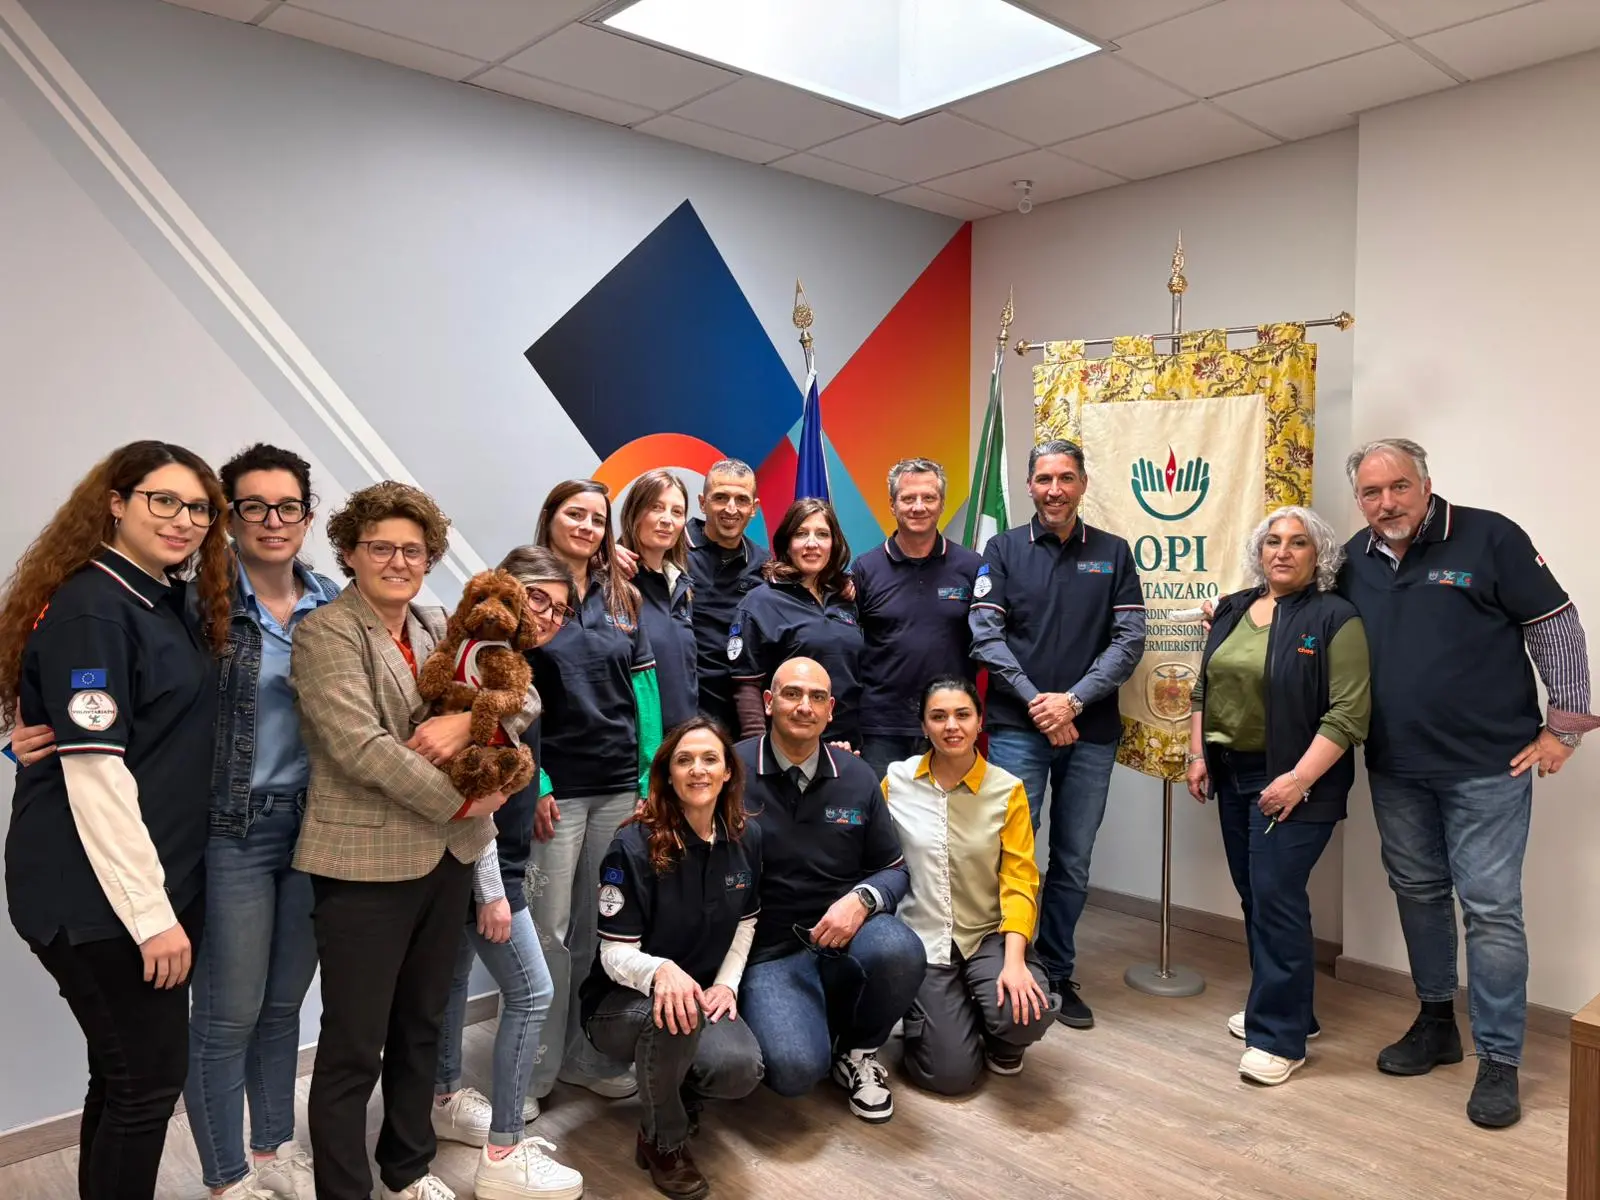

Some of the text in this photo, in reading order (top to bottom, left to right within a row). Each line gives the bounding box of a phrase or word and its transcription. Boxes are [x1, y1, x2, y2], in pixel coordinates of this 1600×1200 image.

[1134, 535, 1208, 572] OPI
[1142, 582, 1218, 600] TANZARO
[1144, 608, 1173, 620] RDIN
[1146, 624, 1204, 636] ROFESSIONI
[1144, 640, 1208, 652] ERMIERISTIC
